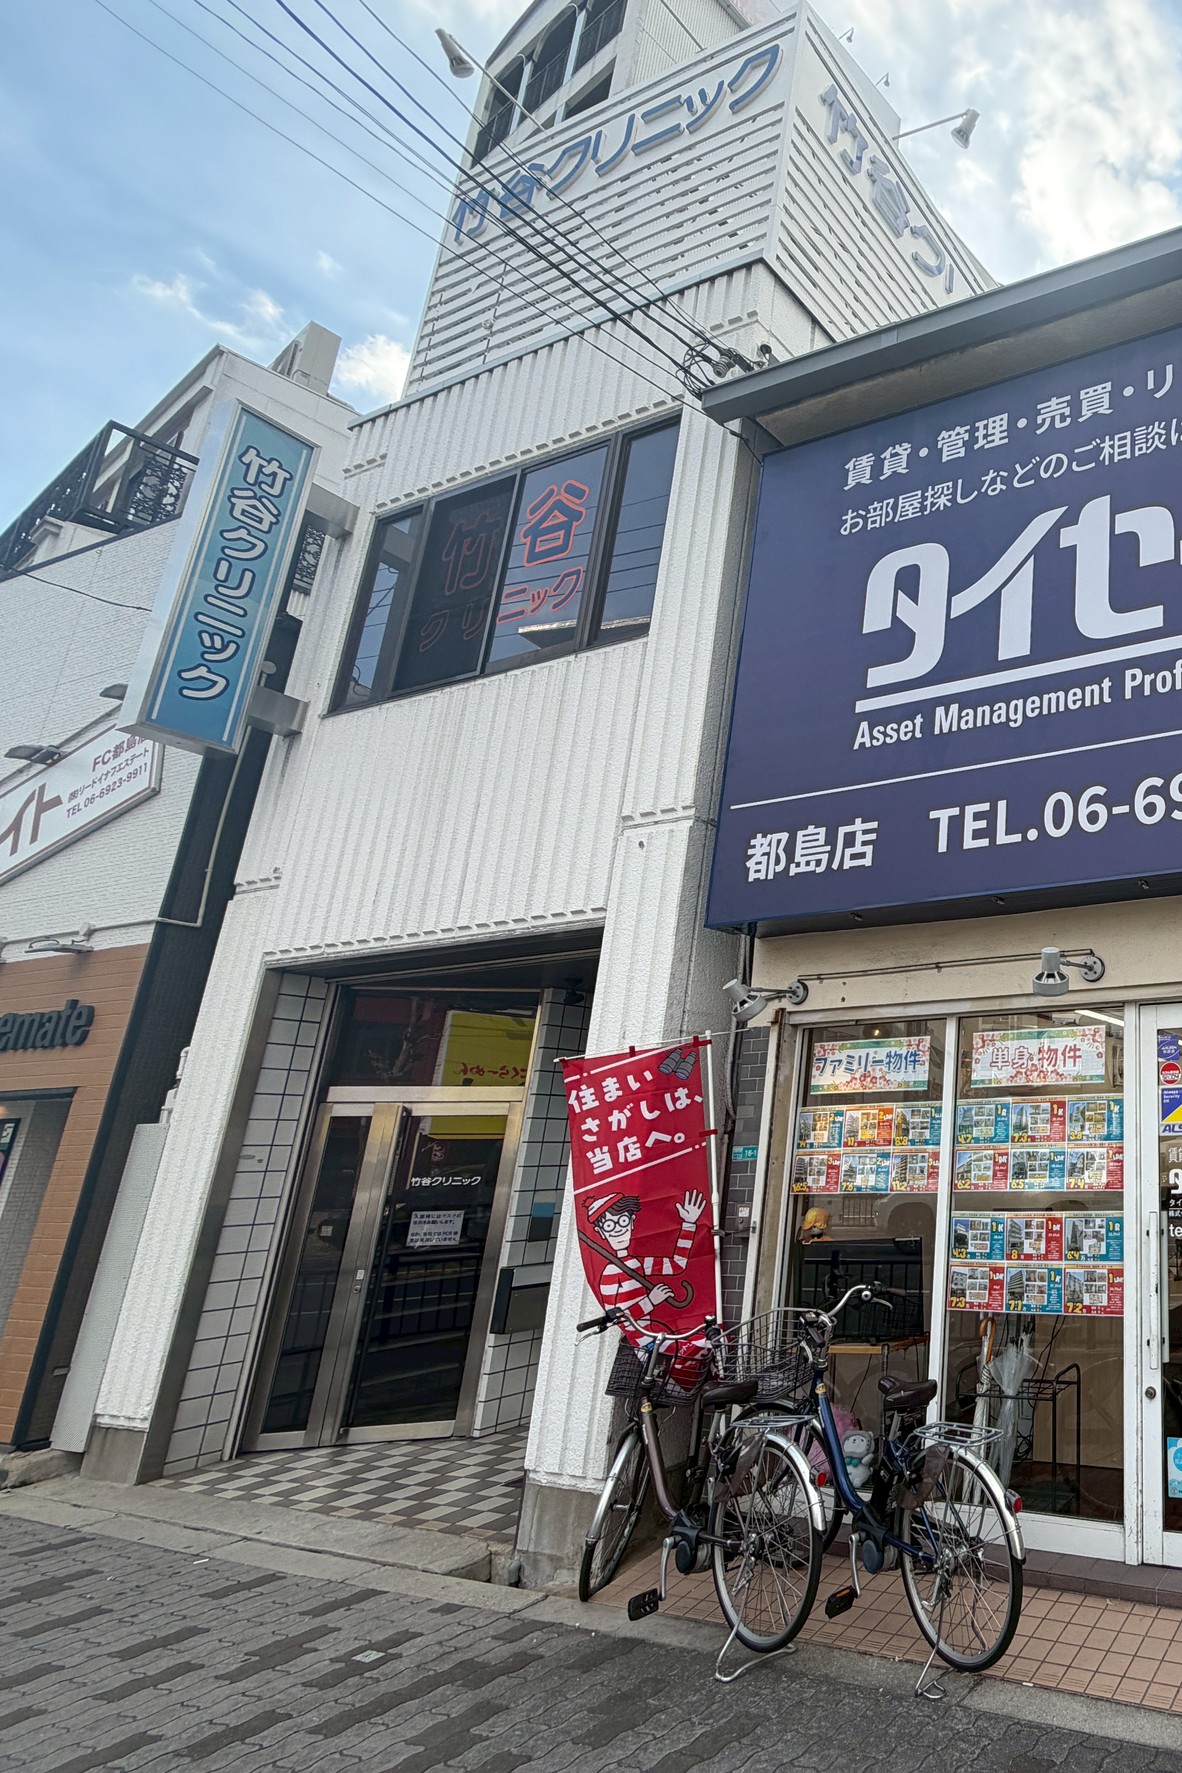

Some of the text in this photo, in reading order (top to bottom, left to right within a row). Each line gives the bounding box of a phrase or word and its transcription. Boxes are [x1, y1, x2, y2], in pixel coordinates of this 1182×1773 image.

[452, 43, 782, 243] 竹谷クリニック
[819, 84, 955, 294] 竹谷ク
[177, 445, 293, 700] 竹谷クリニック
[853, 714, 922, 749] Asset
[933, 674, 1111, 735] Management
[67, 763, 148, 818] TEL 06-6923-9911
[745, 817, 879, 882] 都島店
[814, 1050, 921, 1077] ファミリー物件
[568, 1070, 653, 1113] 住まい
[581, 1087, 703, 1141] さがしは、
[586, 1131, 685, 1174] 当店へ。
[411, 1176, 481, 1187] 竹谷クリニック
